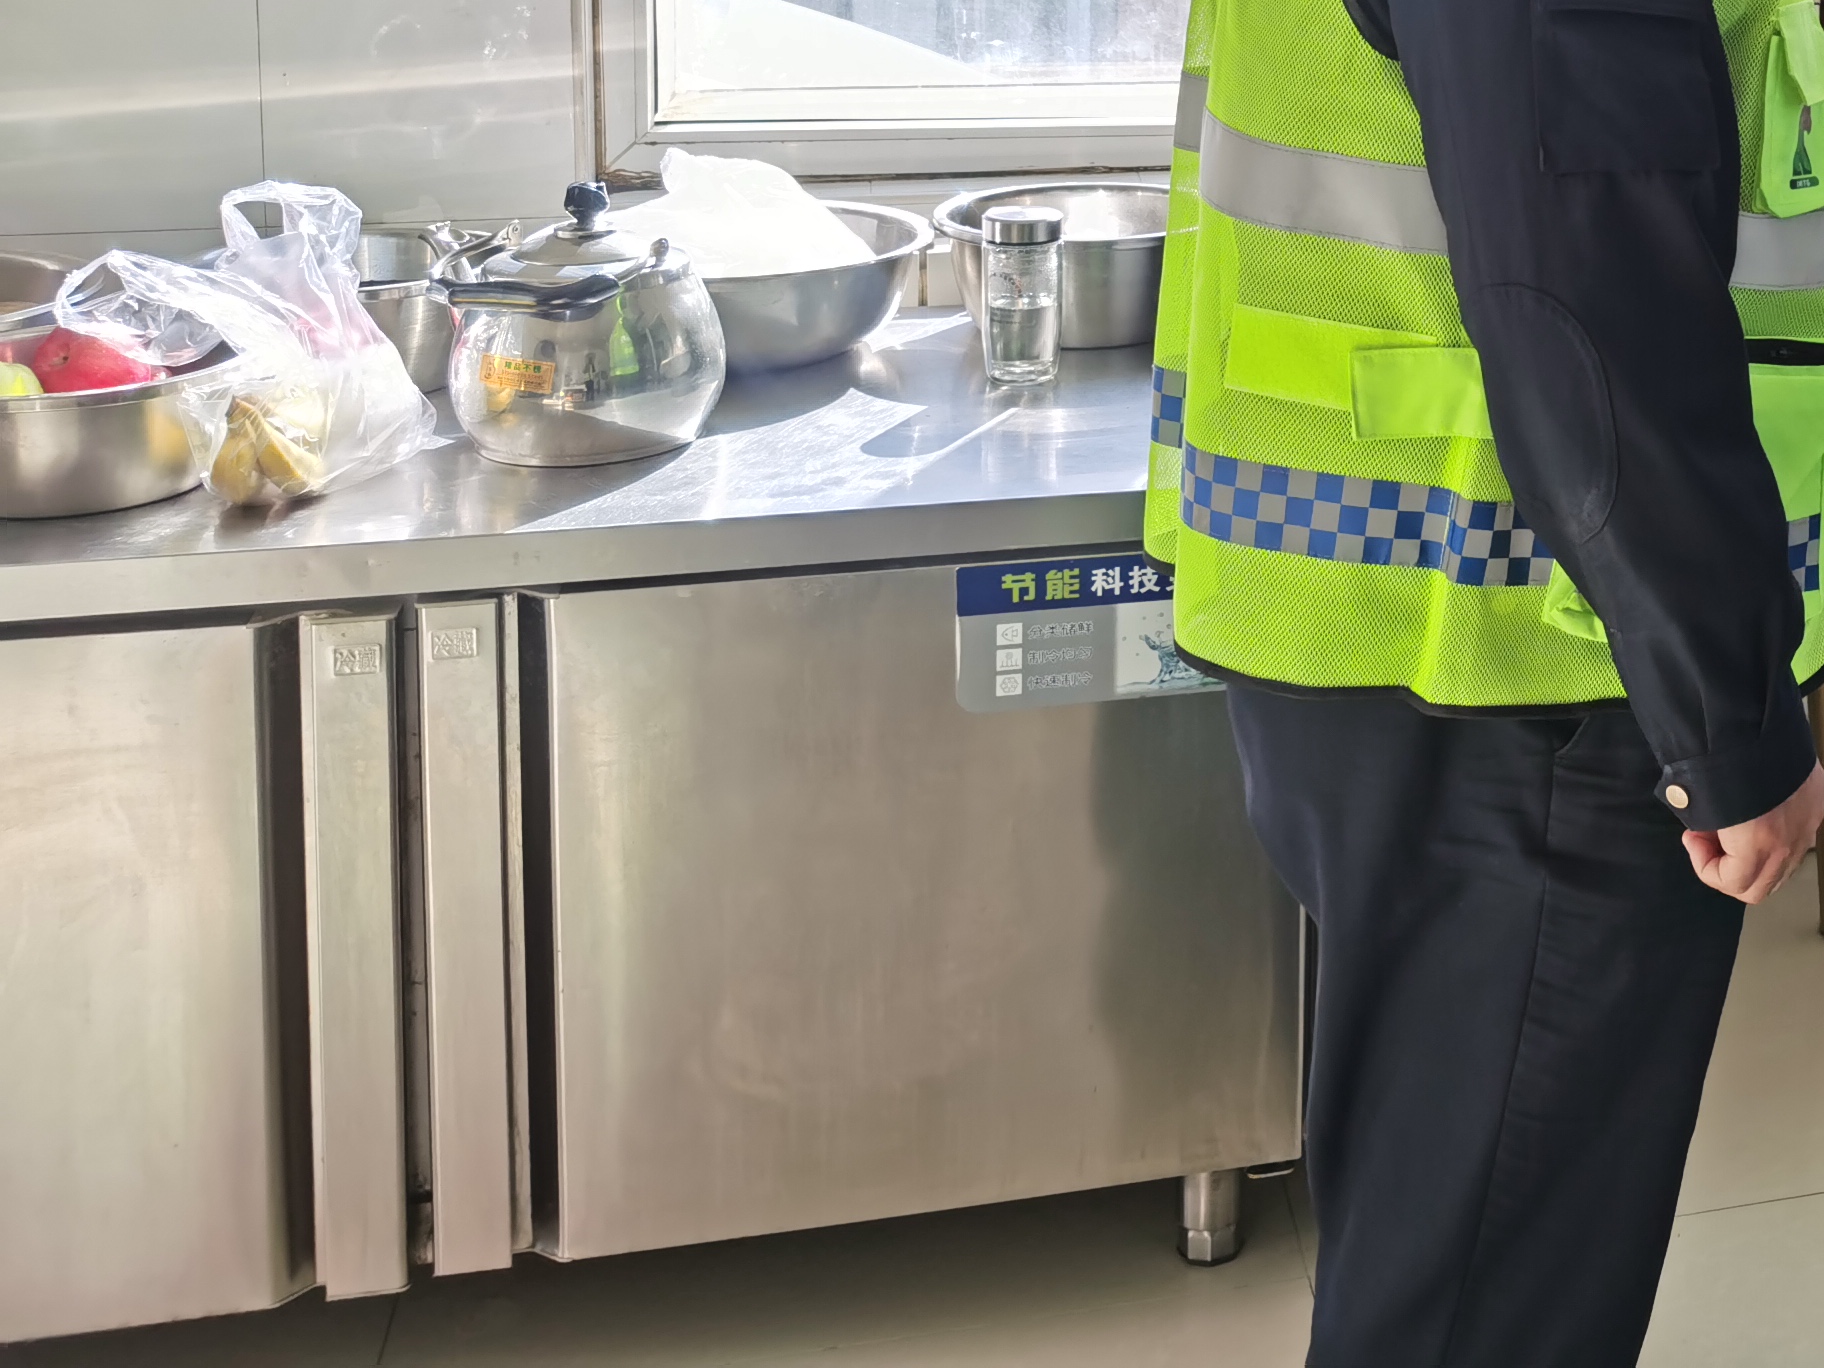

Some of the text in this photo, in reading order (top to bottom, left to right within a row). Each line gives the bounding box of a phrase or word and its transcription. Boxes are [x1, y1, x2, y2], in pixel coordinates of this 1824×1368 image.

[1001, 565, 1175, 604] 节能科技
[1028, 621, 1093, 639] 分类储鲜
[1027, 671, 1093, 690] 快速制冷
